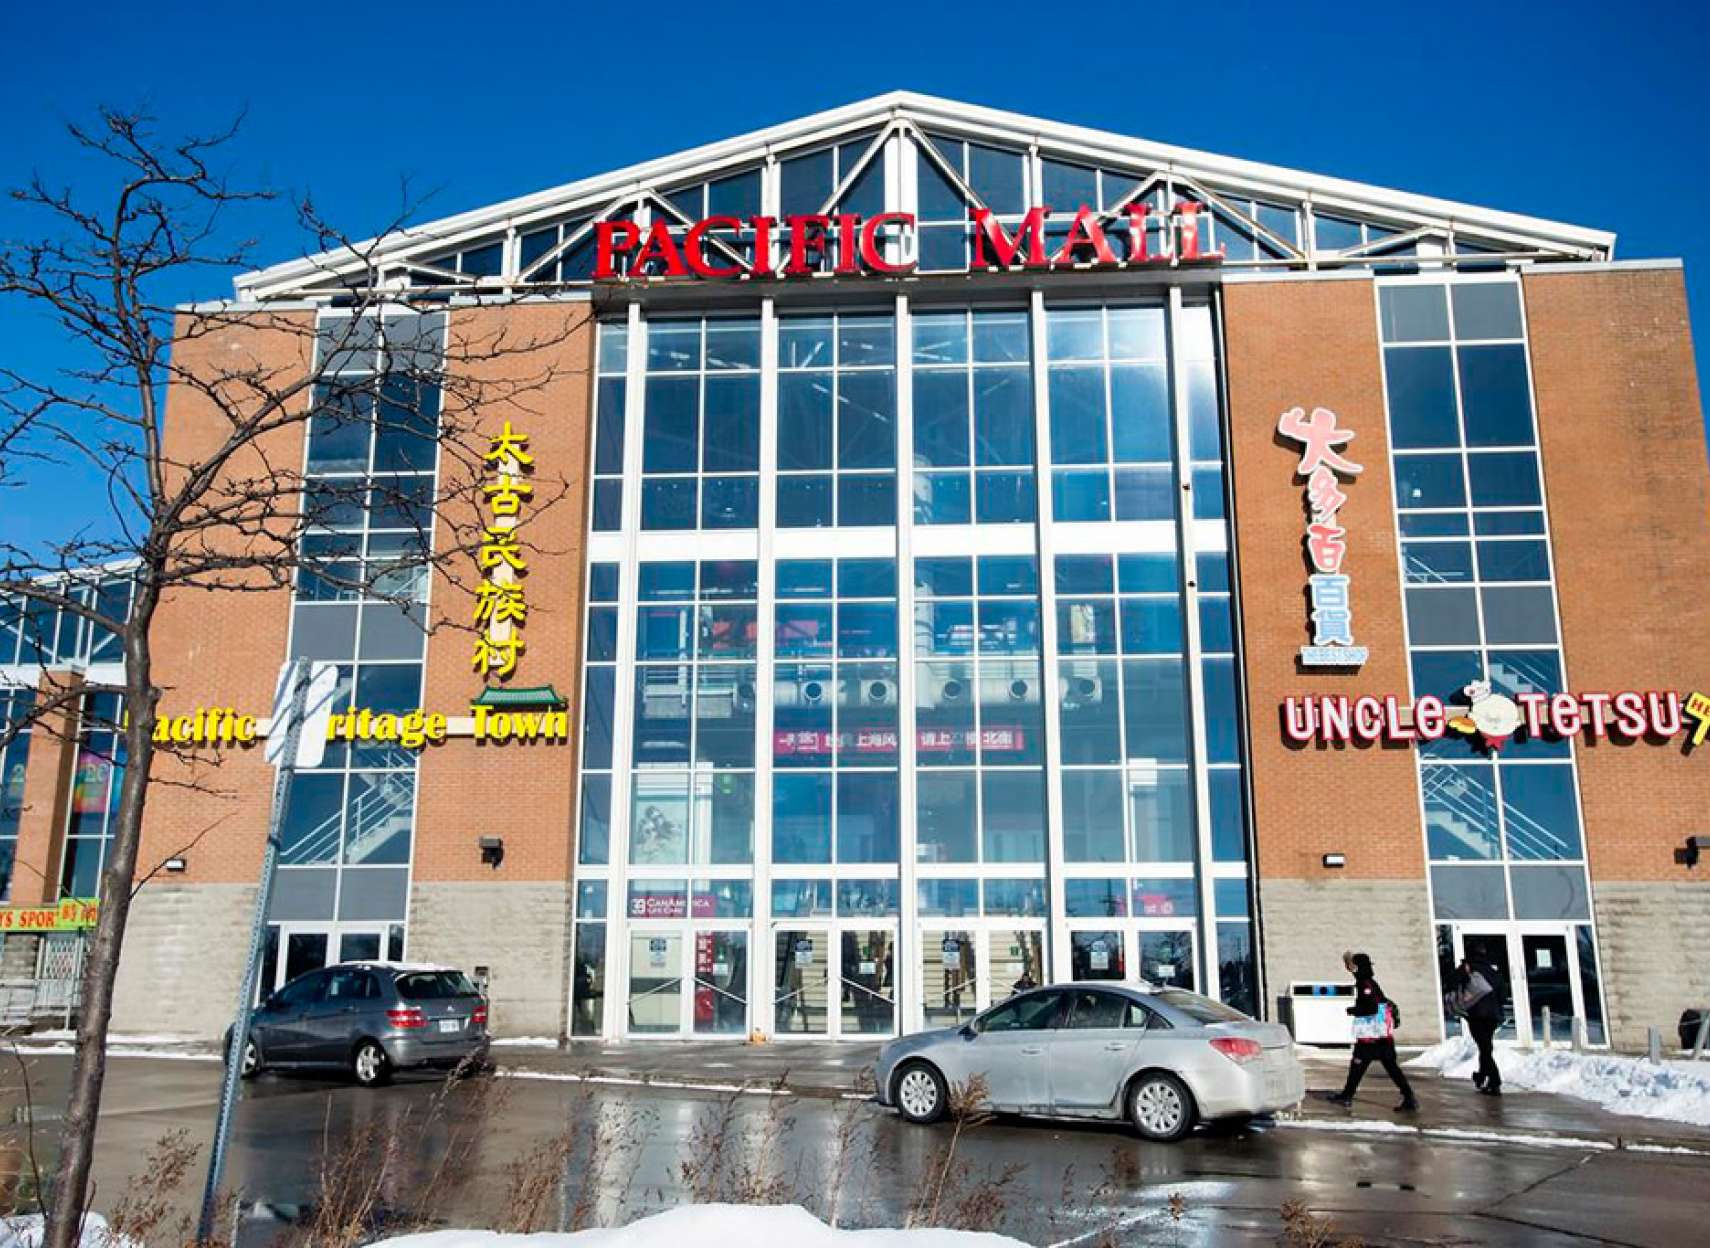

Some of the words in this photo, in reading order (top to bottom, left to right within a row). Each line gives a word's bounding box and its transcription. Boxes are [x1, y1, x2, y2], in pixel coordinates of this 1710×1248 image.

[592, 211, 917, 280] PACIFIC
[968, 202, 1227, 269] MALL
[471, 419, 534, 677] 太古民族村
[124, 706, 257, 742] acific
[325, 706, 447, 748] ritage
[470, 704, 568, 740] Town
